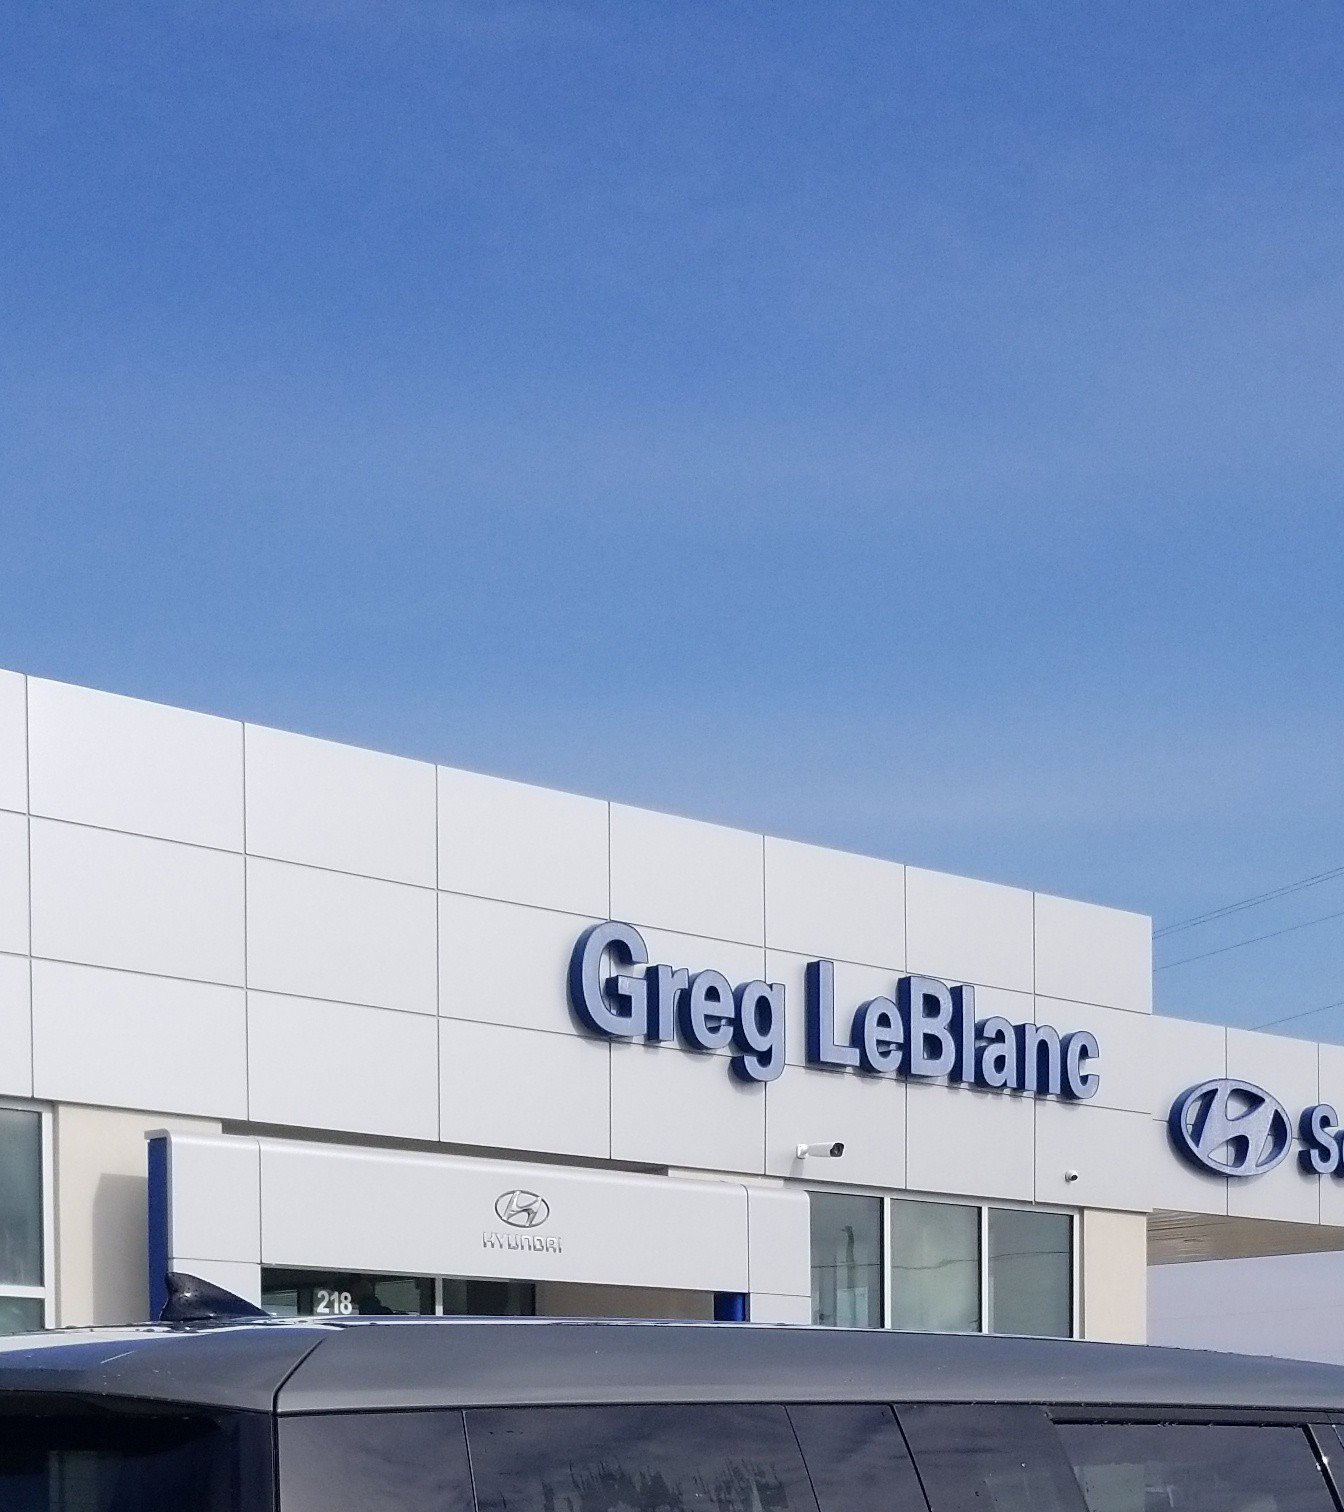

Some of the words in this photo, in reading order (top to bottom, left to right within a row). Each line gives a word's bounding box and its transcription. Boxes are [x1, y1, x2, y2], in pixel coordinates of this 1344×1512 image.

[569, 921, 786, 1081] Greg
[806, 960, 1101, 1100] LeBlanc
[483, 1232, 562, 1253] HYUNDAI
[317, 1290, 353, 1315] 218
